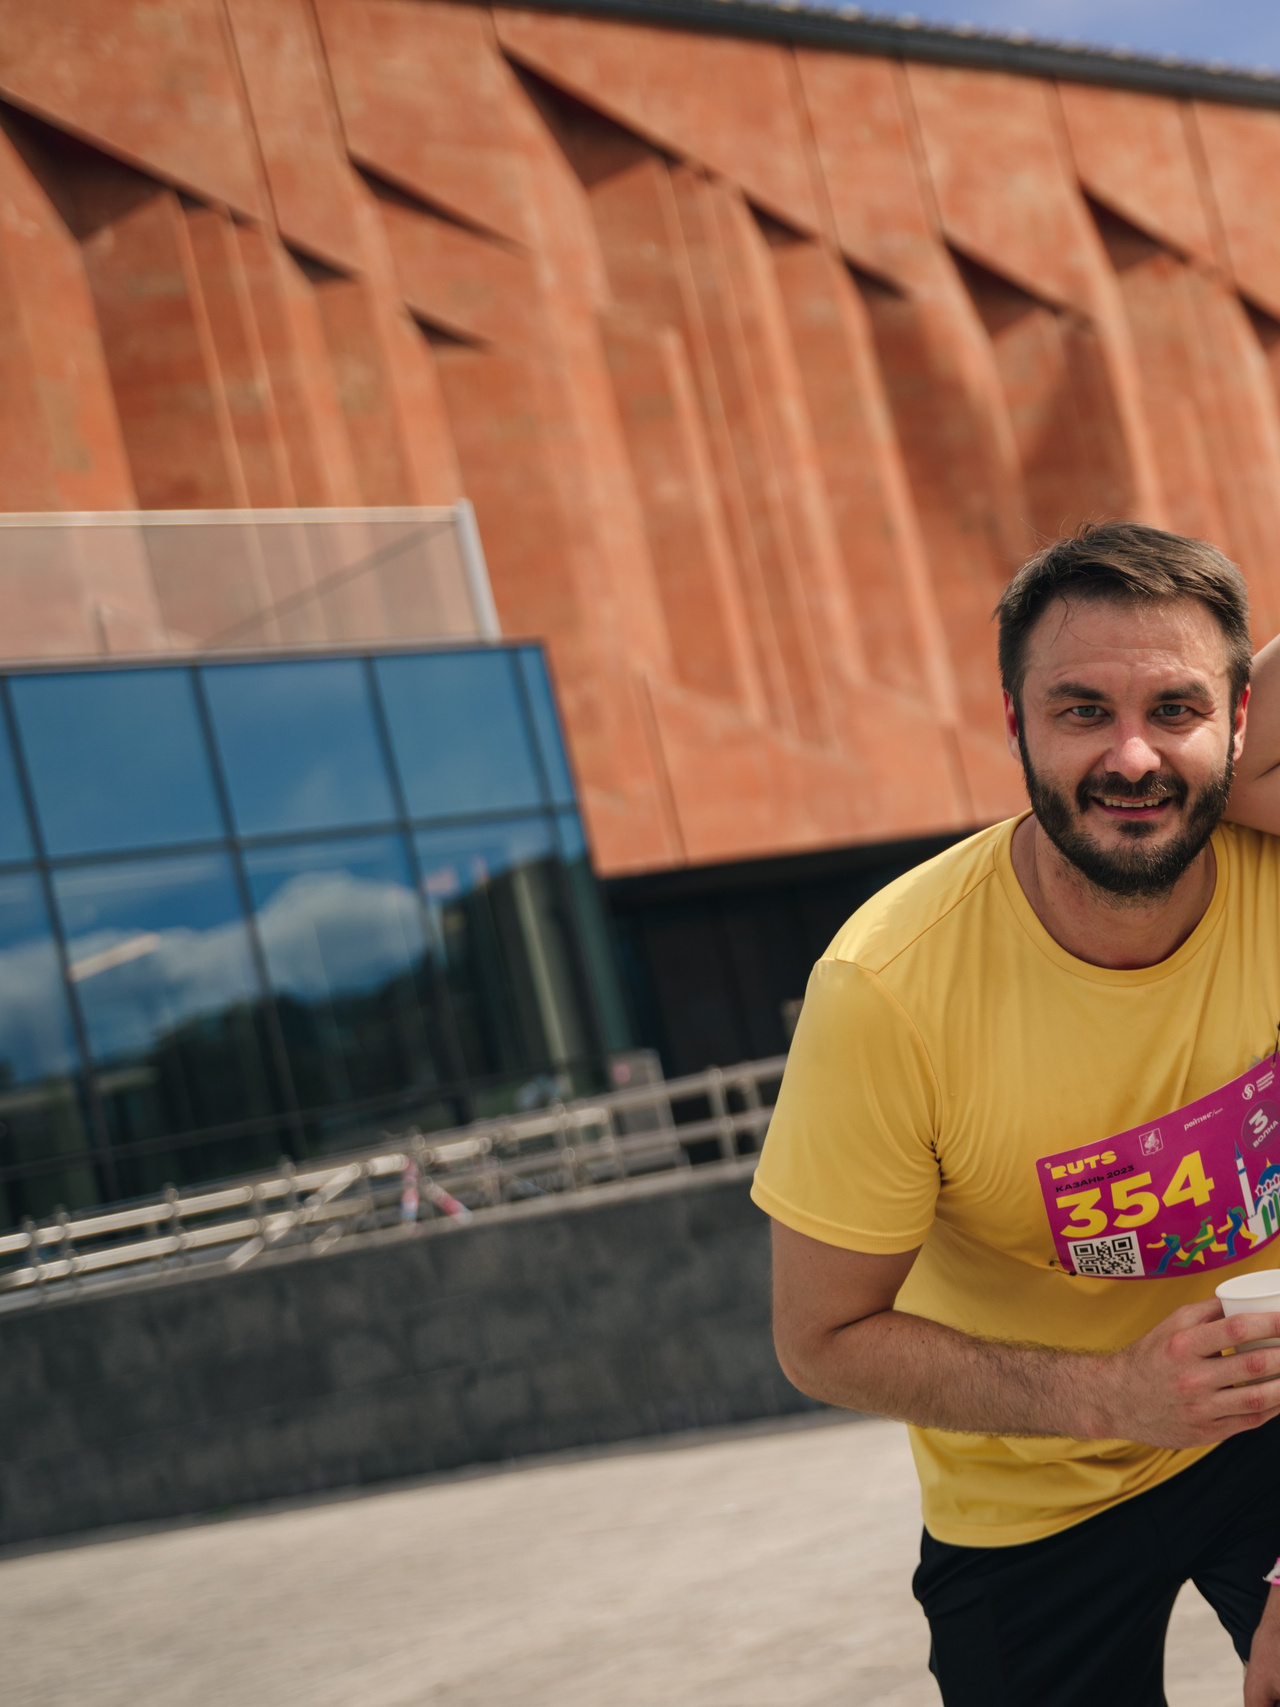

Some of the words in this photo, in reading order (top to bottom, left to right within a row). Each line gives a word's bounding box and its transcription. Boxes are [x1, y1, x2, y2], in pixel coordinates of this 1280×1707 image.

[1248, 1108, 1268, 1134] 3
[1252, 1119, 1279, 1148] ВОЛНА
[1050, 1150, 1117, 1179] RUTS
[1055, 1175, 1105, 1193] КАЗАНЬ
[1106, 1164, 1135, 1179] 2023
[1056, 1150, 1215, 1238] 354
